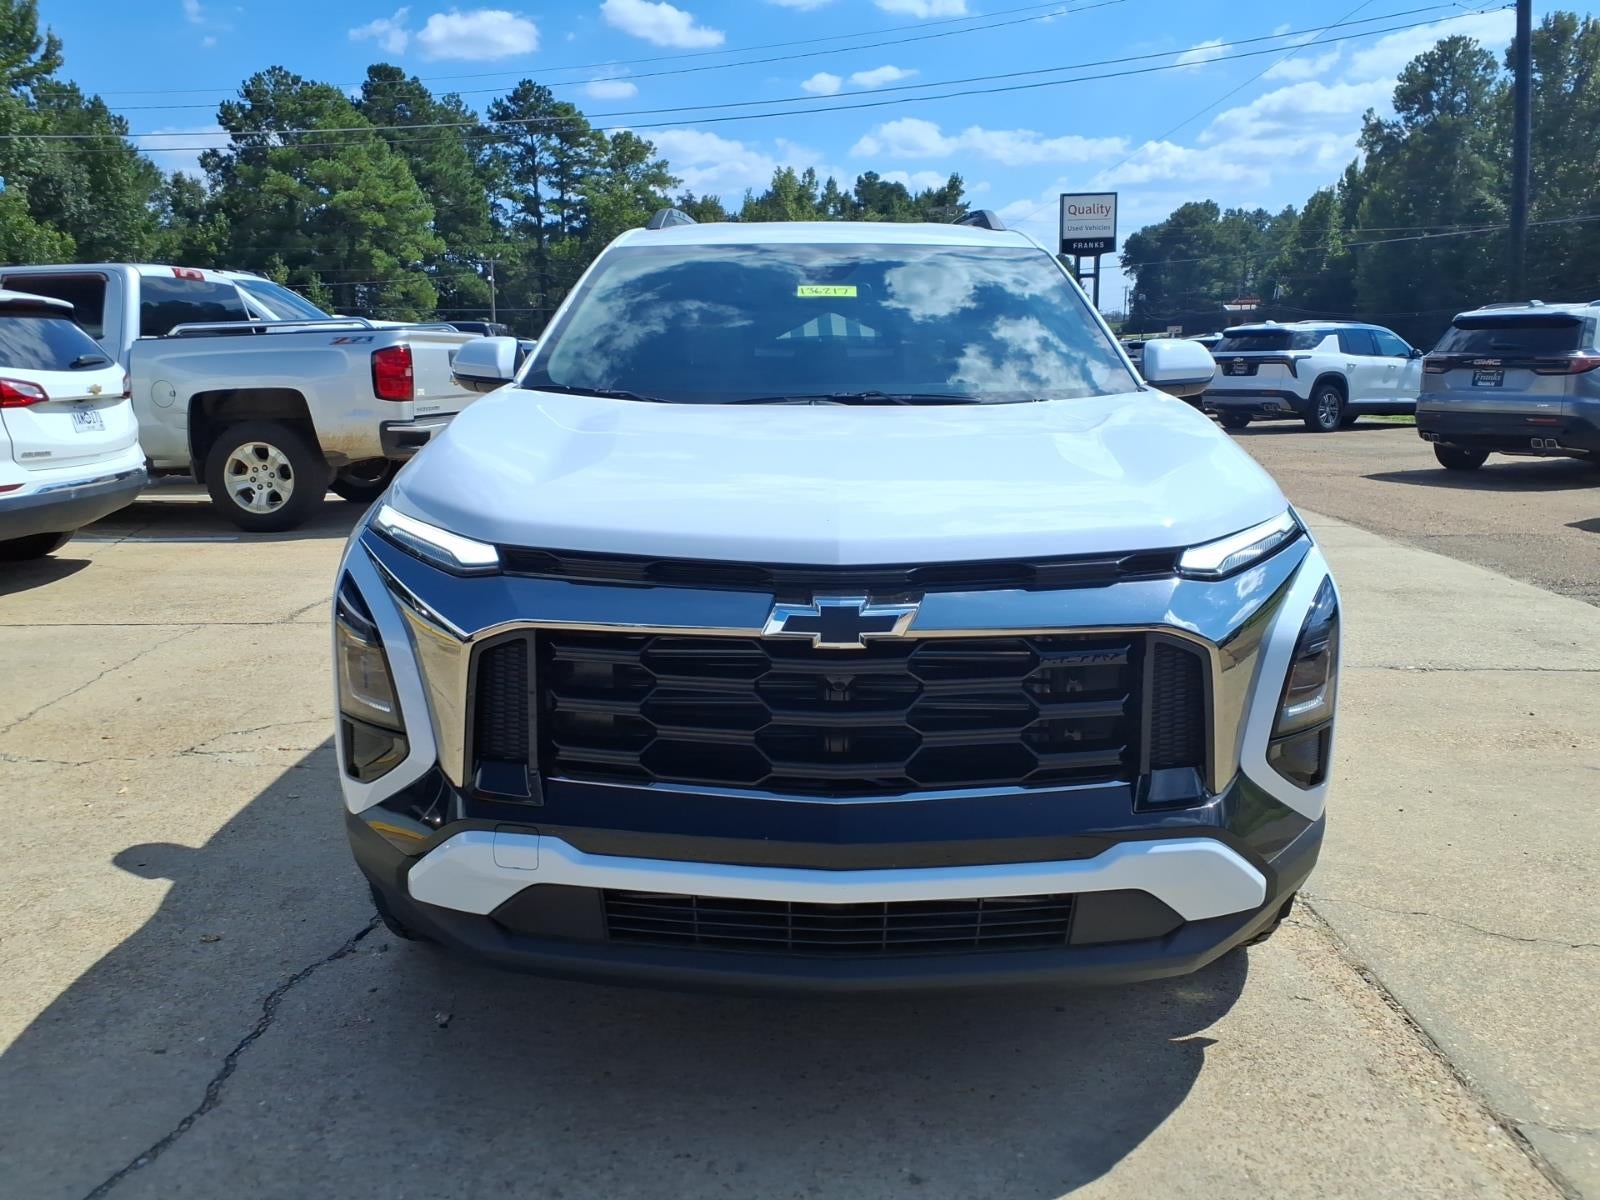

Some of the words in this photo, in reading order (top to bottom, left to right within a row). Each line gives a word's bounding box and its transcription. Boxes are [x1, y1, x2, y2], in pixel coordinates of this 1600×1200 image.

[1068, 204, 1111, 217] Quality
[1073, 241, 1105, 249] FRANKS
[329, 335, 376, 345] Z71
[1473, 358, 1502, 366] GMC
